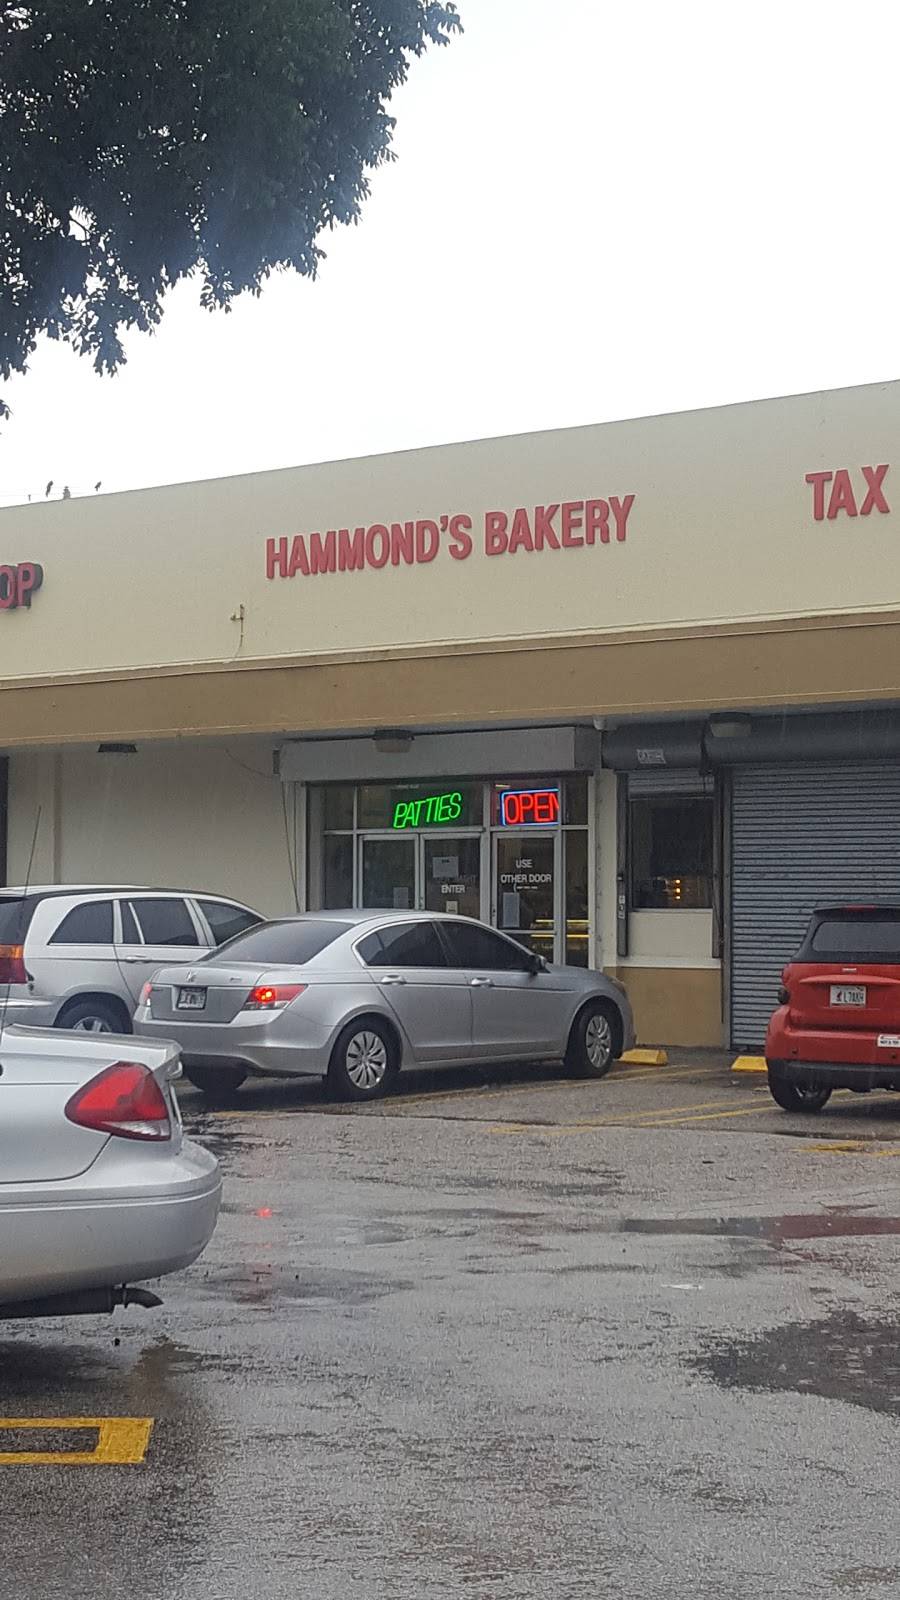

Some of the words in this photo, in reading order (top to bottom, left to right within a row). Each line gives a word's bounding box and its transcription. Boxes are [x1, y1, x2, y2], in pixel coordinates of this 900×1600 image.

[805, 464, 890, 520] TAX
[266, 514, 472, 579] HAMMOND'S
[485, 494, 635, 556] BAKERY
[393, 792, 462, 828] PATTIES
[515, 859, 533, 868] USE
[441, 883, 466, 893] ENTER
[500, 873, 527, 883] OTHER
[528, 873, 551, 883] DOOR
